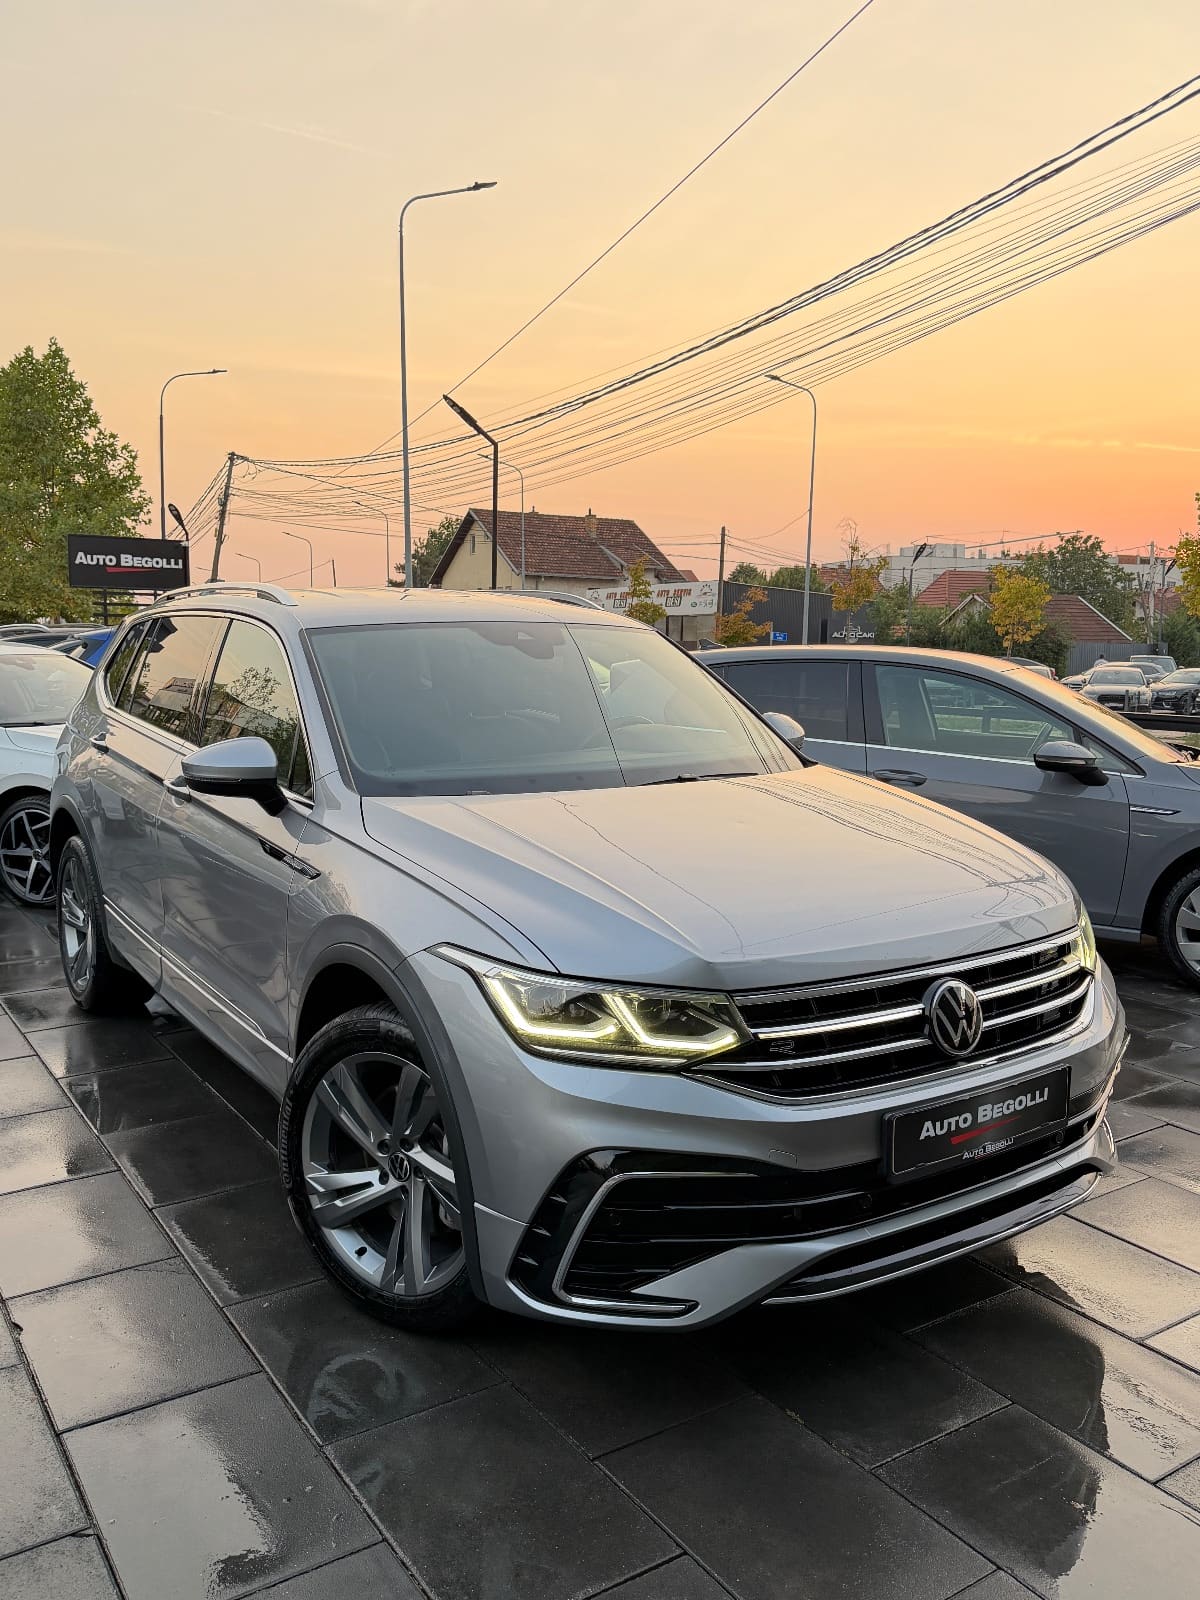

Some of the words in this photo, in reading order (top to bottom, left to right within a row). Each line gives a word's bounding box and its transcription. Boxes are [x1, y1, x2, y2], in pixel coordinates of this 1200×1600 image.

[75, 551, 117, 566] AUTO
[120, 554, 183, 569] BEGOLLI
[919, 1112, 973, 1140] AUTO
[977, 1087, 1049, 1123] BEGOLLI
[962, 1148, 984, 1160] AUTO
